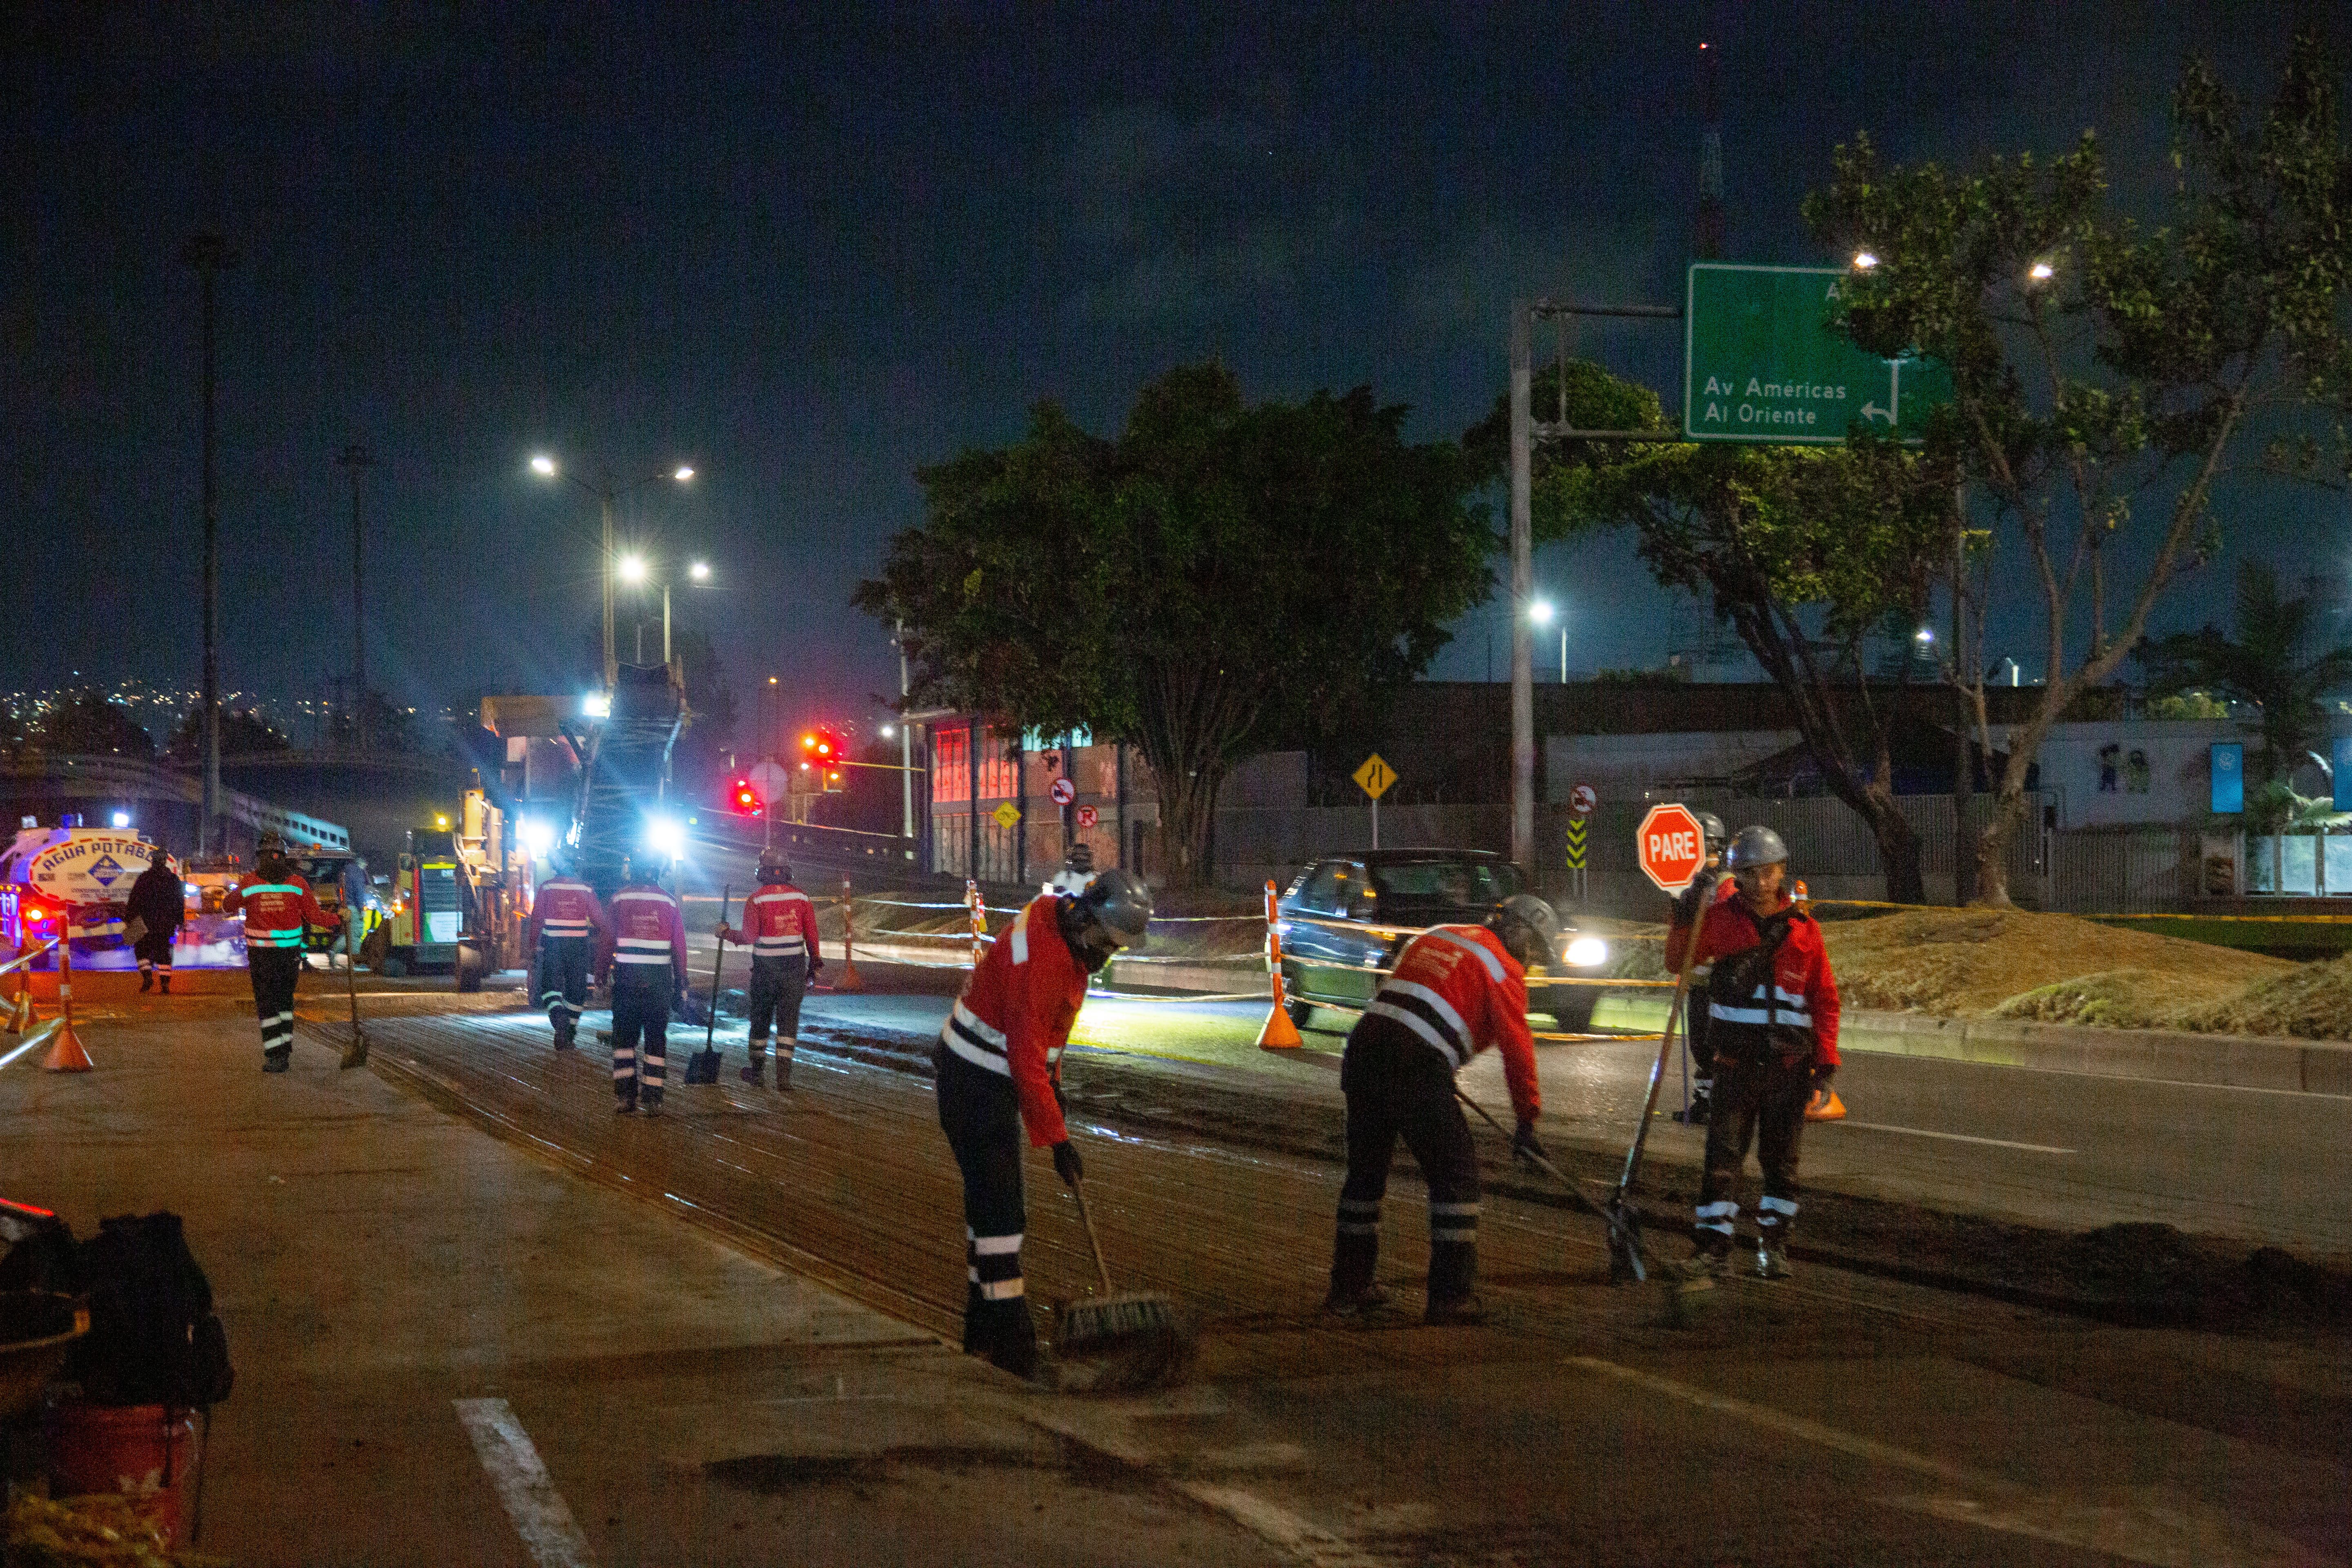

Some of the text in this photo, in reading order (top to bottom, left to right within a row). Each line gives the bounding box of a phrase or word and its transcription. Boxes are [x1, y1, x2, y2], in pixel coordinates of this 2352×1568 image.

[1705, 377, 1733, 395] Av
[1705, 403, 1816, 424] Al Oriente
[43, 843, 153, 871] AGUA POTABL
[1650, 831, 1696, 862] PARE
